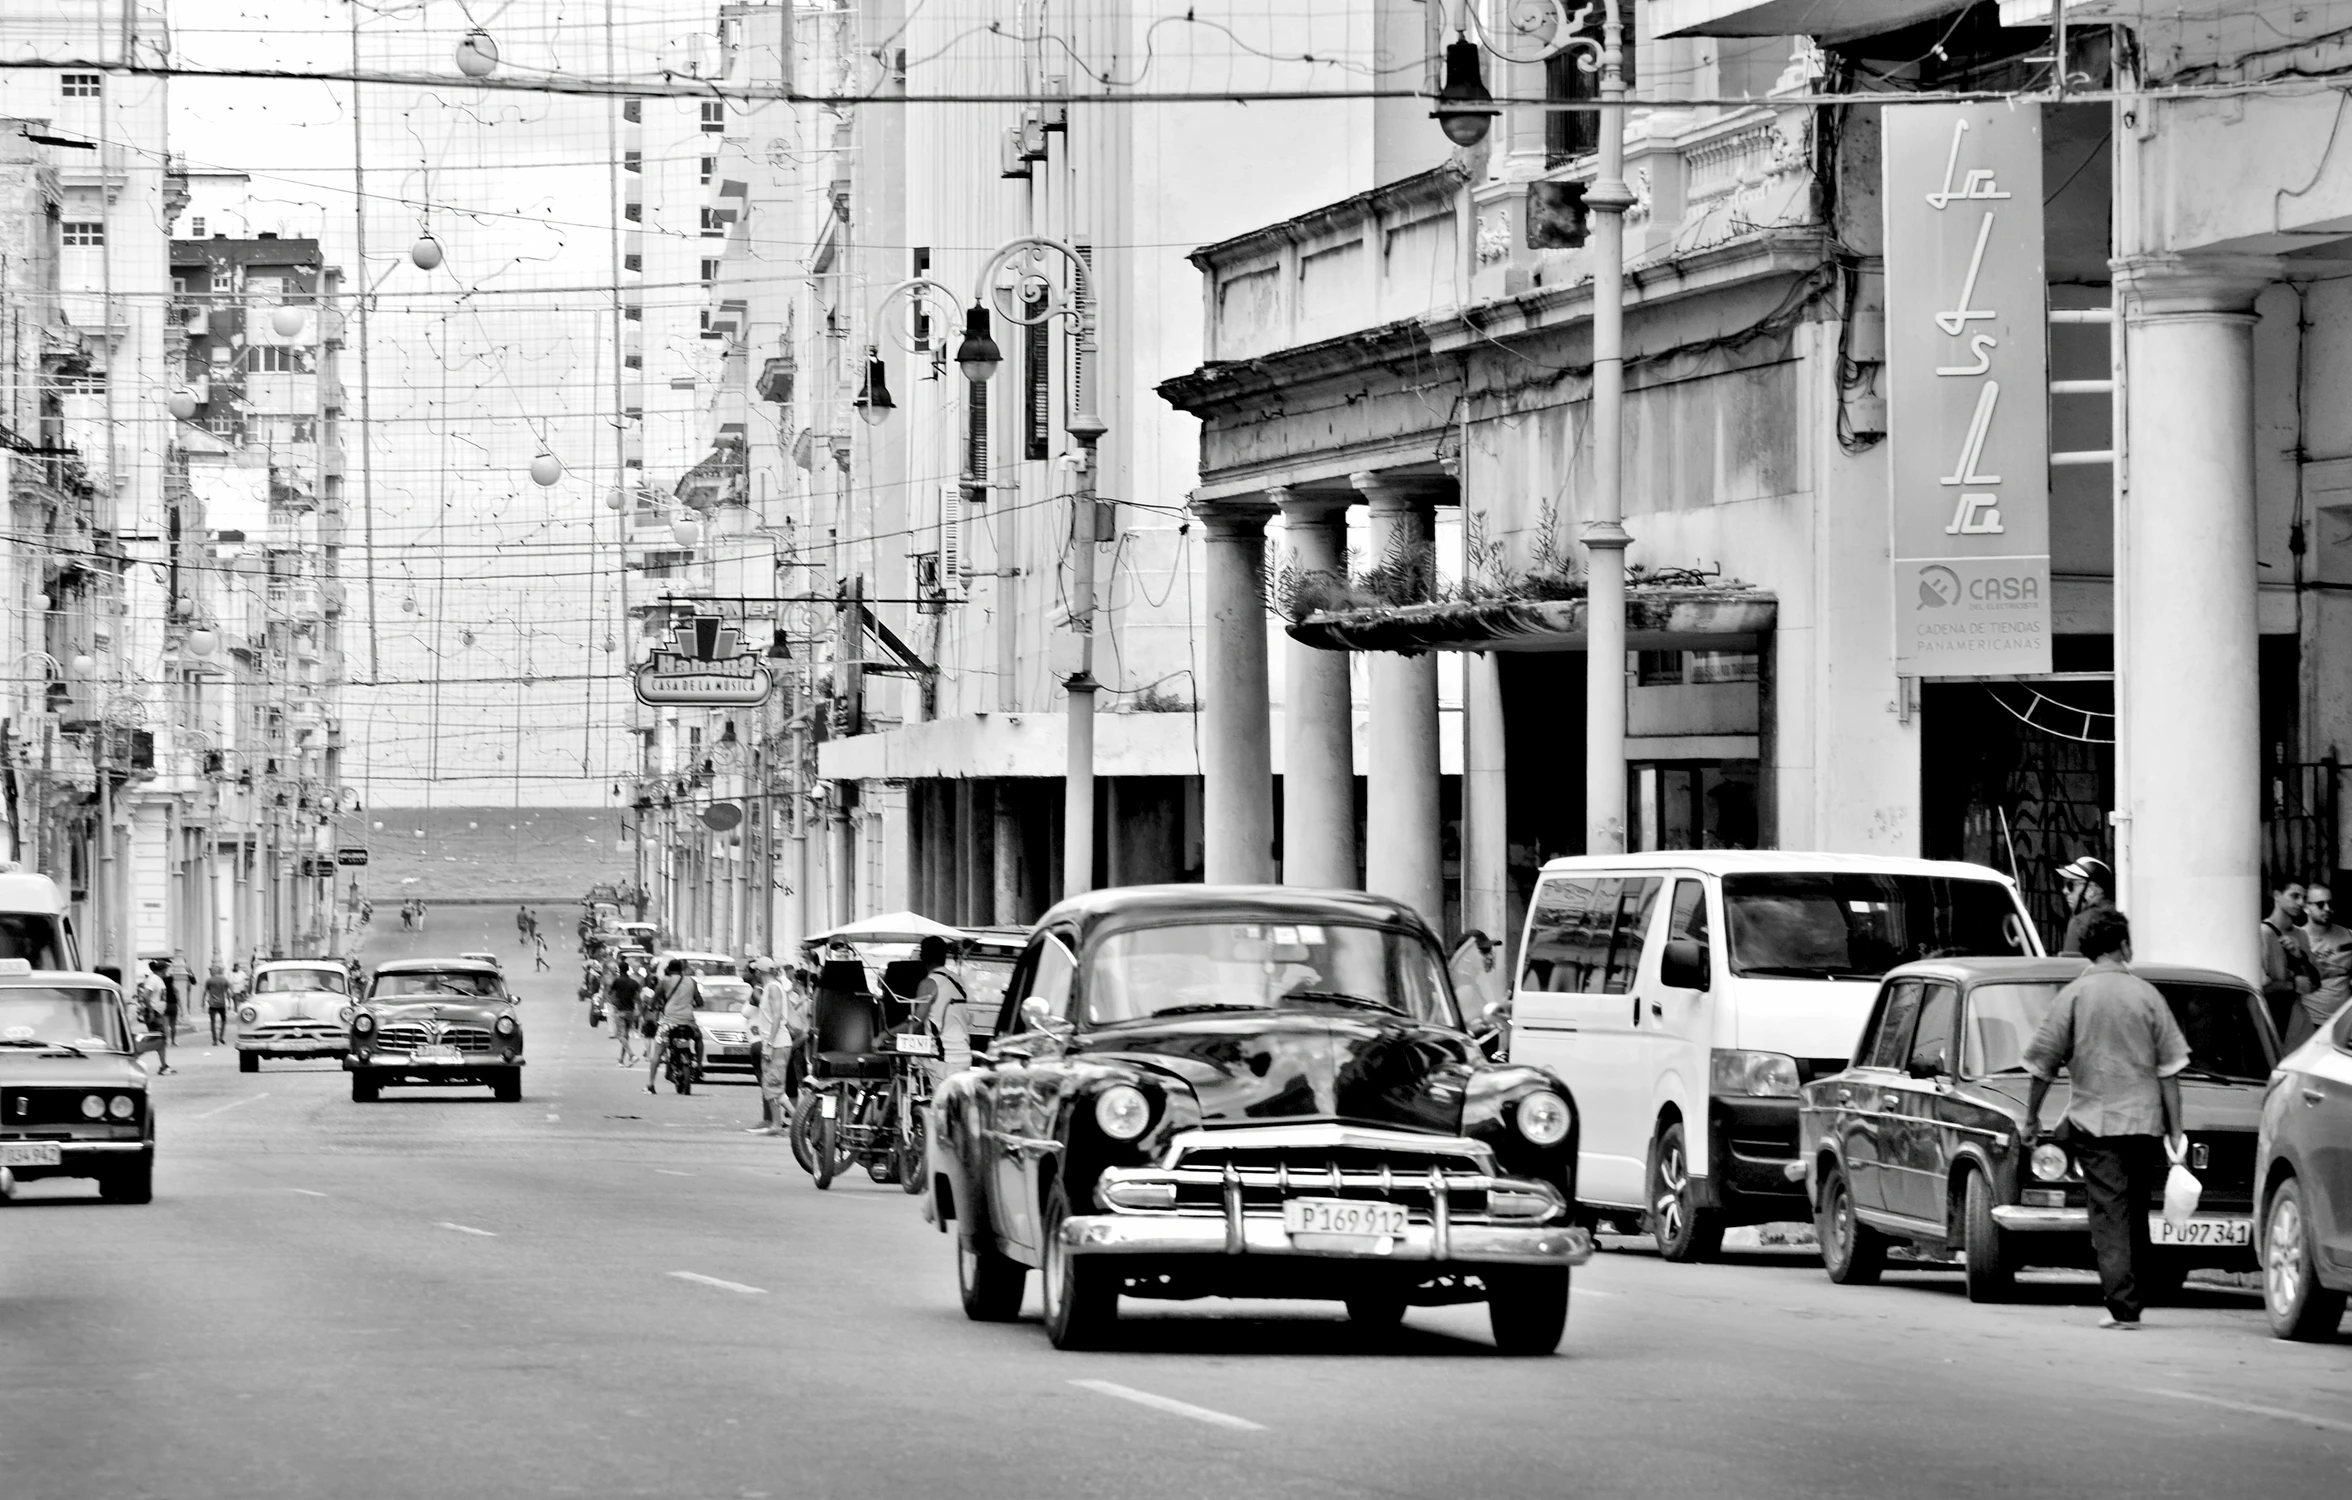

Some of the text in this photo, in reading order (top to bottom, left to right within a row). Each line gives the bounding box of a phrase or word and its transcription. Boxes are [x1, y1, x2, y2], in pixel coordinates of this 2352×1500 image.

[1969, 576, 2039, 600] CASA
[1916, 620, 2040, 636] CADENA DE TIENDAS
[1917, 637, 2041, 652] PANAMERICANAS
[658, 654, 755, 678] Habana
[651, 679, 678, 691] CASA
[682, 679, 695, 691] DE
[699, 679, 711, 691] LA
